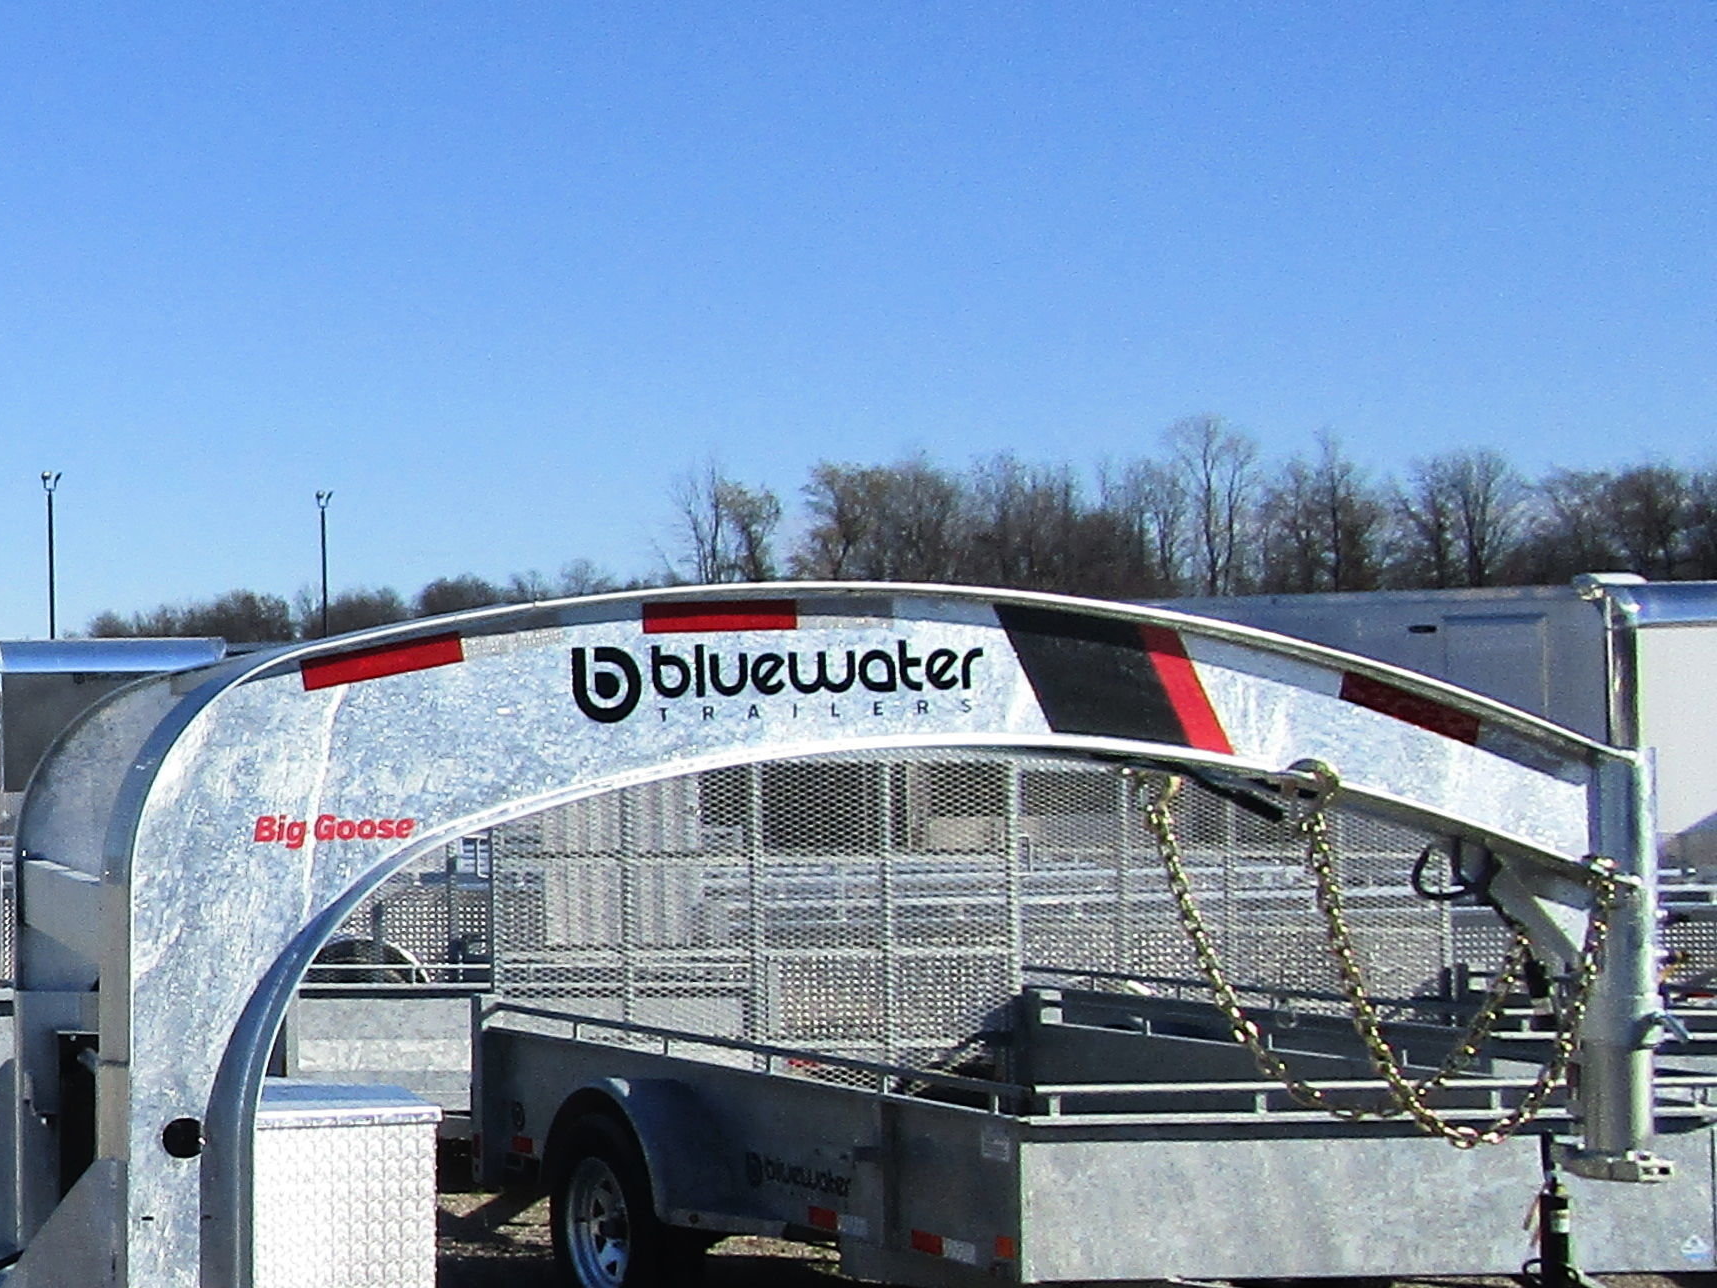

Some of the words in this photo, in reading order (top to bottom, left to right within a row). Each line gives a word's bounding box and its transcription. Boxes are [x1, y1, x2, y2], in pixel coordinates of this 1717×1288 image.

[651, 639, 984, 699] bluewater
[659, 699, 973, 724] TRAILERS
[253, 815, 307, 850] Big
[315, 814, 415, 841] Goose
